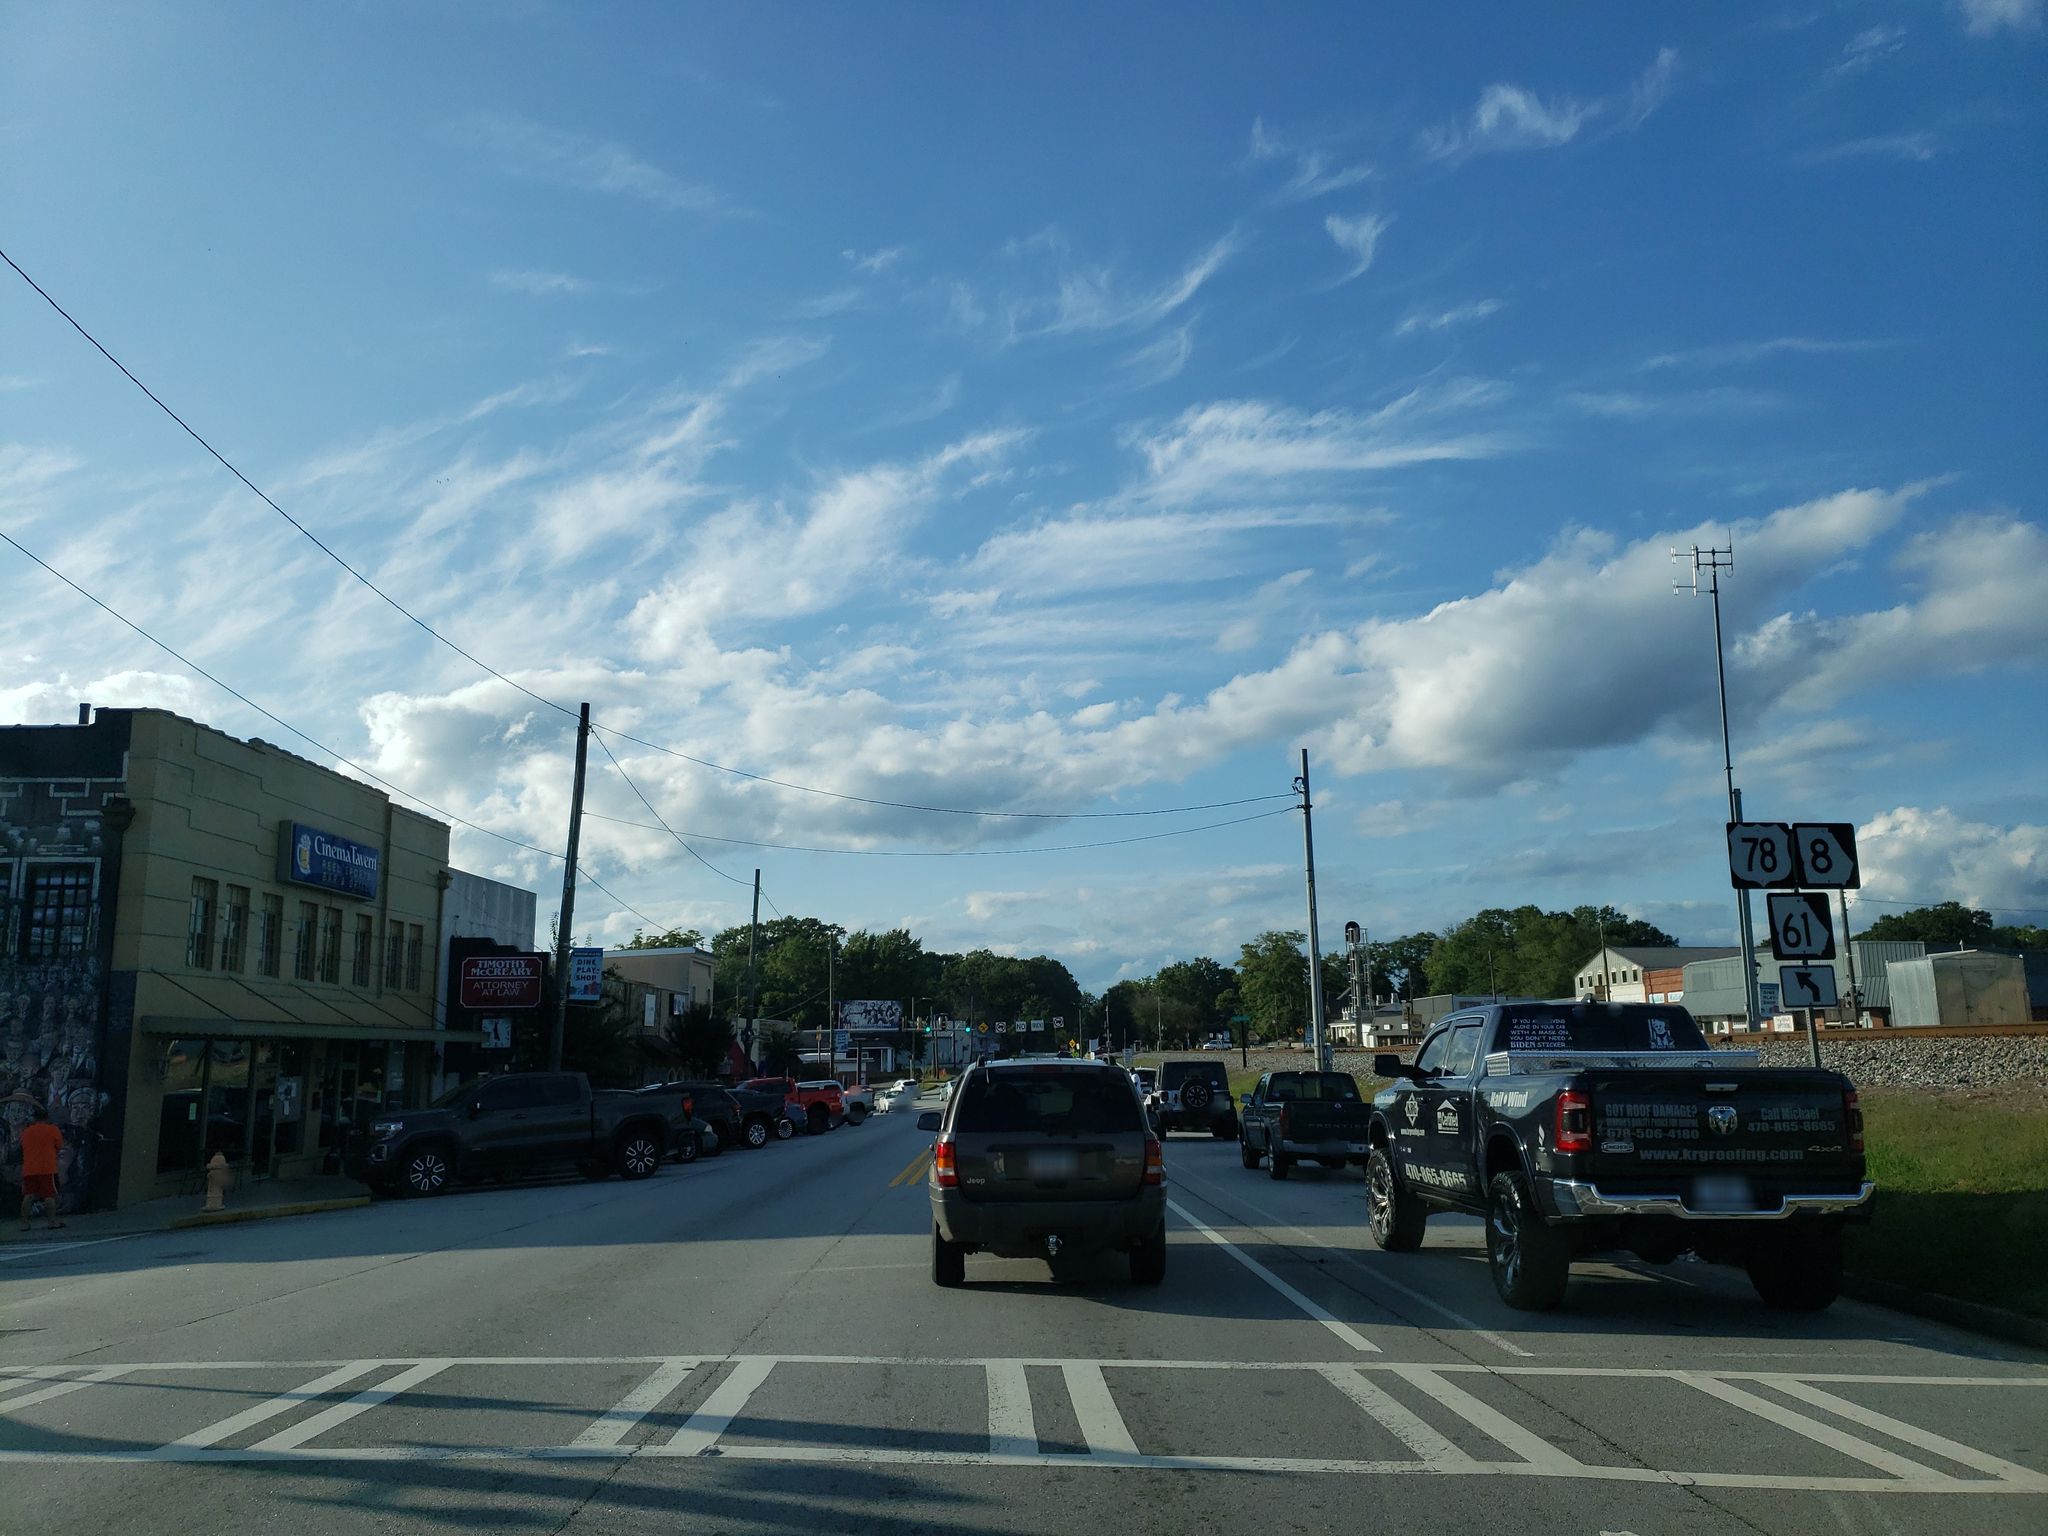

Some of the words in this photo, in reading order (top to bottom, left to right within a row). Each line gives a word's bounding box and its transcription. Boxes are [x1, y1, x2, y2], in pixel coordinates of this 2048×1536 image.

[314, 835, 350, 863] Cinema
[350, 845, 377, 871] Tavern
[1741, 838, 1777, 873] 78
[1810, 838, 1832, 873] 8
[1783, 912, 1811, 948] 61
[478, 960, 528, 969] TIMOTHY
[473, 981, 529, 989] ATTORNEY
[481, 988, 494, 997] AT
[497, 988, 520, 996] LAW
[1507, 1091, 1529, 1107] Wind
[1605, 1103, 1624, 1117] GOT
[1626, 1103, 1651, 1117] ROOF
[1652, 1103, 1698, 1118] DAMAGE?
[1760, 1107, 1780, 1120] Call
[1781, 1107, 1819, 1121] Michael
[1747, 1121, 1836, 1132] 470-865-8665
[1639, 1148, 1803, 1162] www.krgroofing.com
[1807, 1144, 1842, 1153] 4x4
[966, 1177, 986, 1186] Jeep
[1405, 1163, 1468, 1189] 470-865-8665
